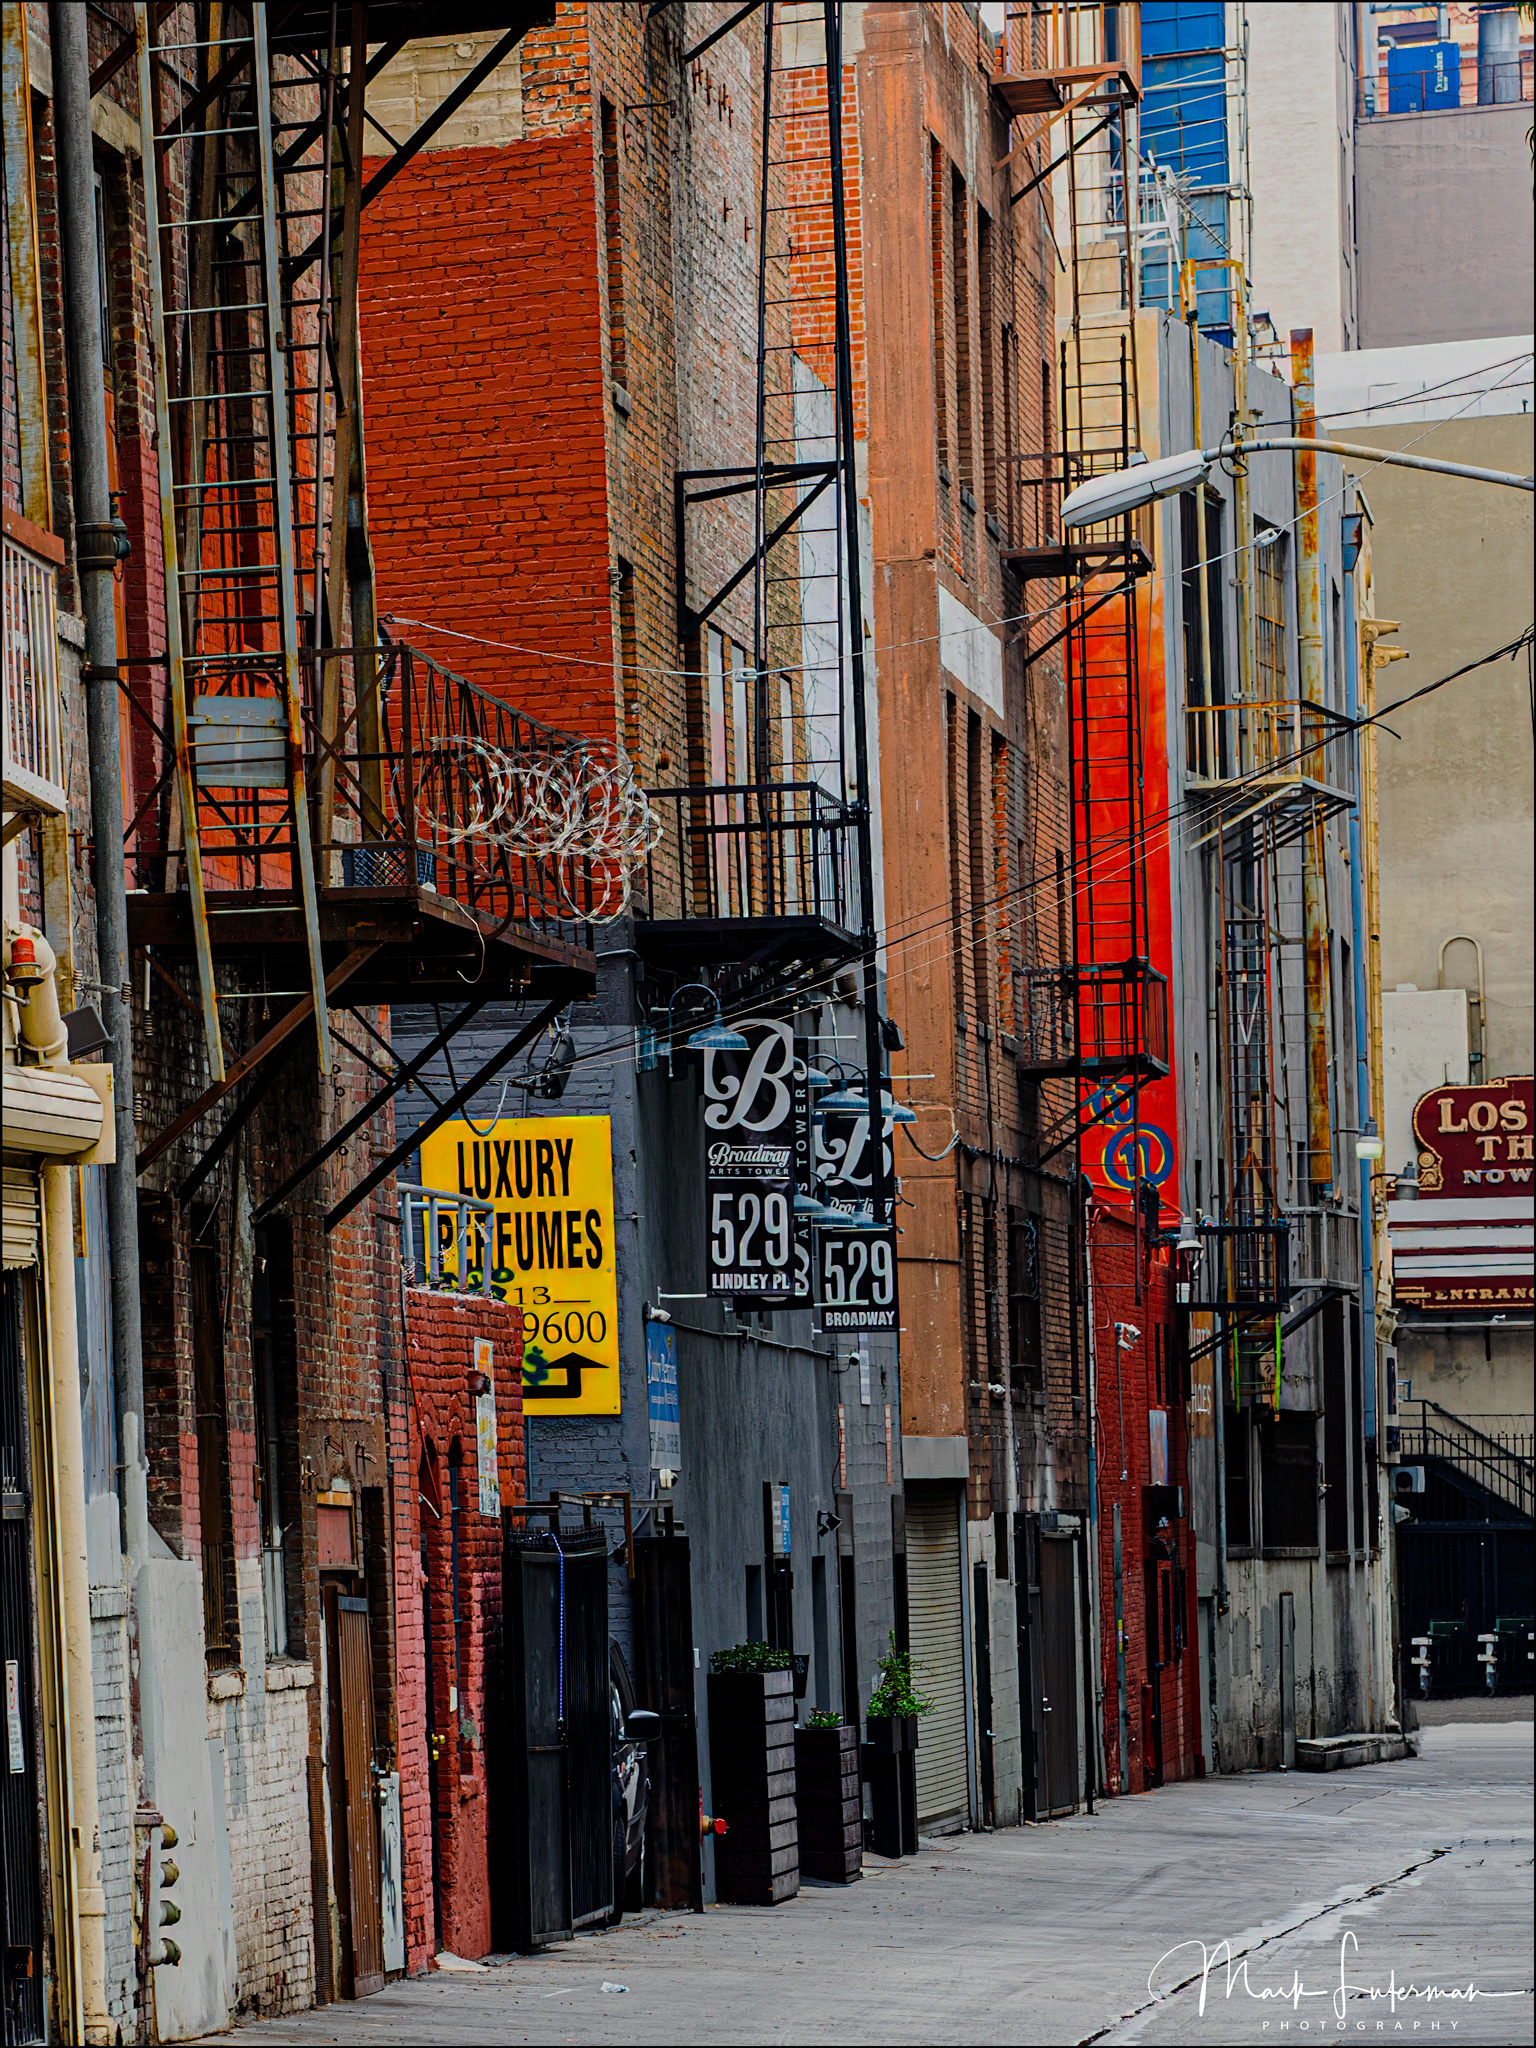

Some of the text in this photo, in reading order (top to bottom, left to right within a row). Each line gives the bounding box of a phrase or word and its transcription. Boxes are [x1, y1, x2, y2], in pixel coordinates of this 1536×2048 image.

[796, 1088, 807, 1168] TOWER
[457, 1138, 573, 1200] LUXURY
[708, 1142, 790, 1168] Broadway
[1463, 1168, 1533, 1184] NOW
[711, 1192, 789, 1267] 529
[711, 1272, 791, 1290] LINDLEY PL
[825, 1240, 894, 1306] 529
[825, 1311, 895, 1326] BROADWAY
